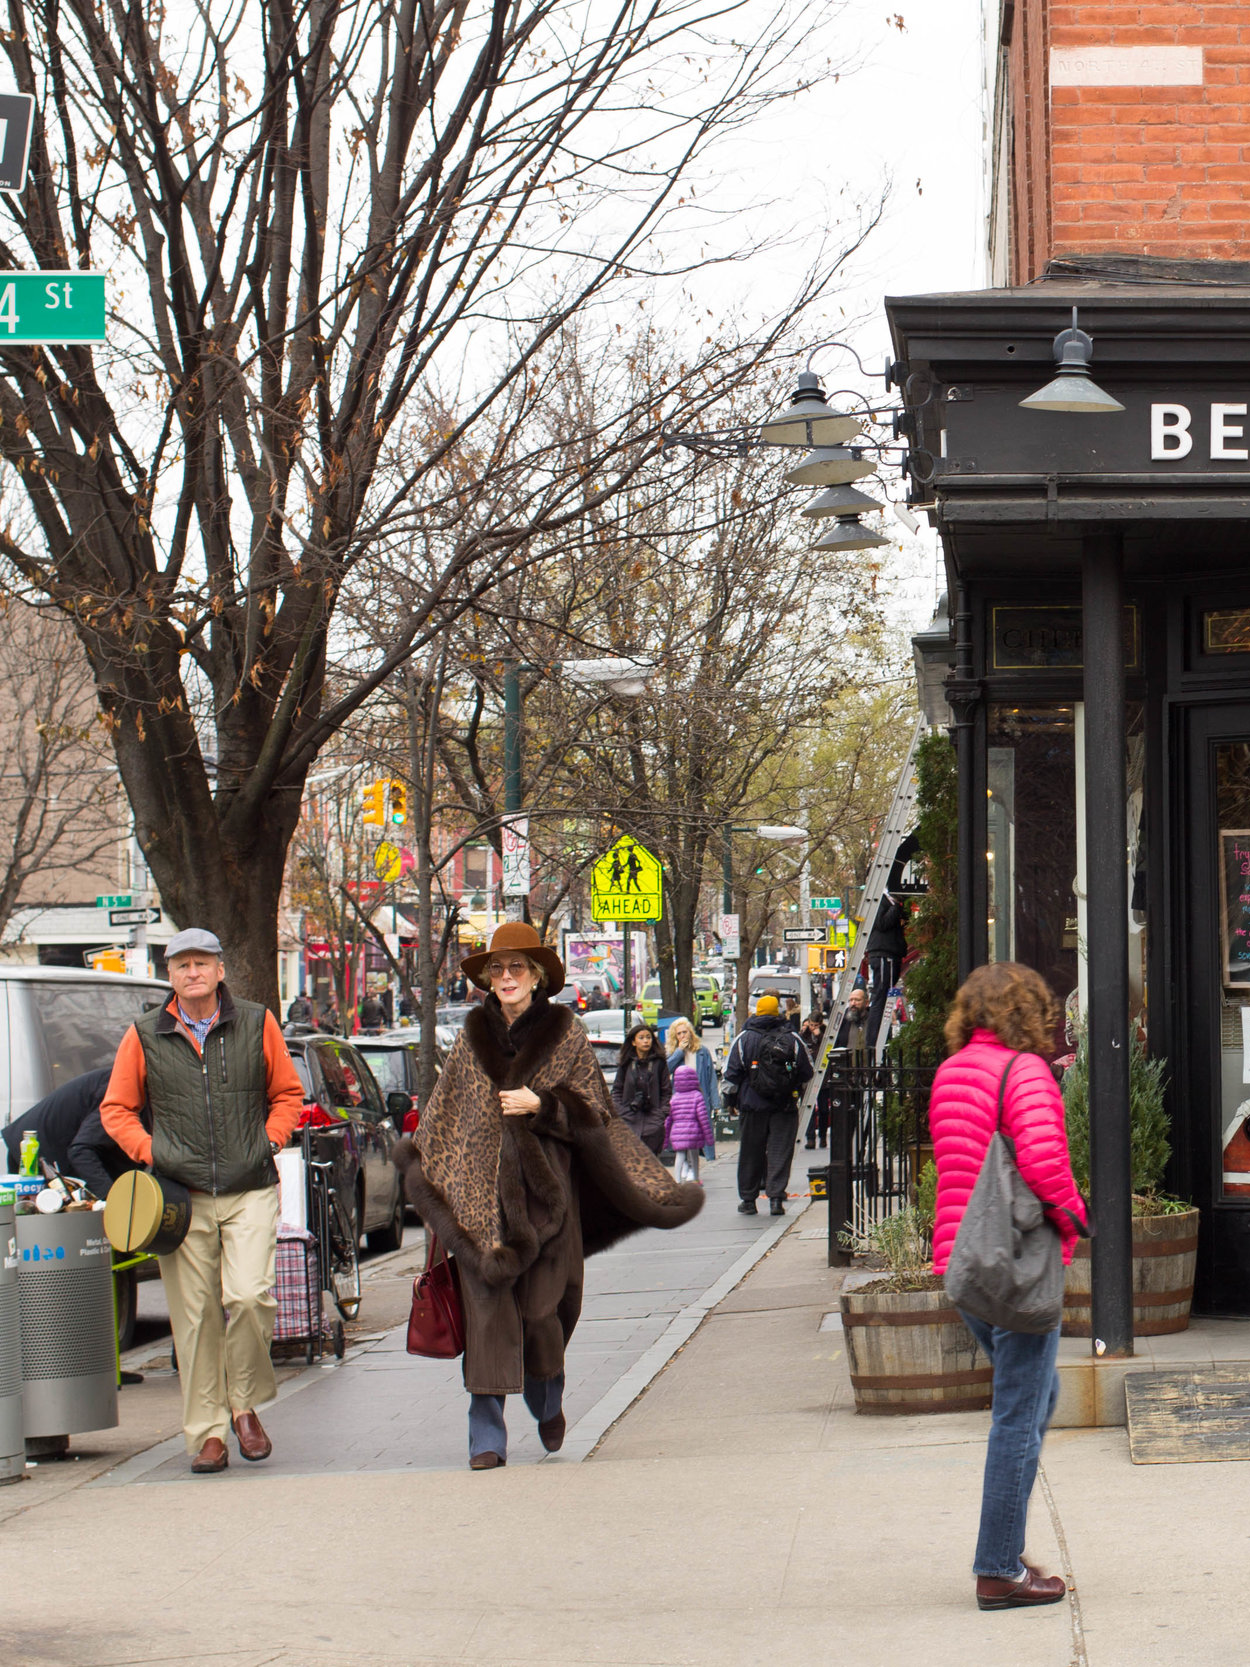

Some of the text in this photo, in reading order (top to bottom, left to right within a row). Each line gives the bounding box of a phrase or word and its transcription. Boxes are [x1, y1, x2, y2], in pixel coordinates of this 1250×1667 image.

[44, 282, 73, 308] St
[1234, 843, 1249, 860] try
[603, 899, 651, 914] AHEAD
[1235, 927, 1246, 937] the
